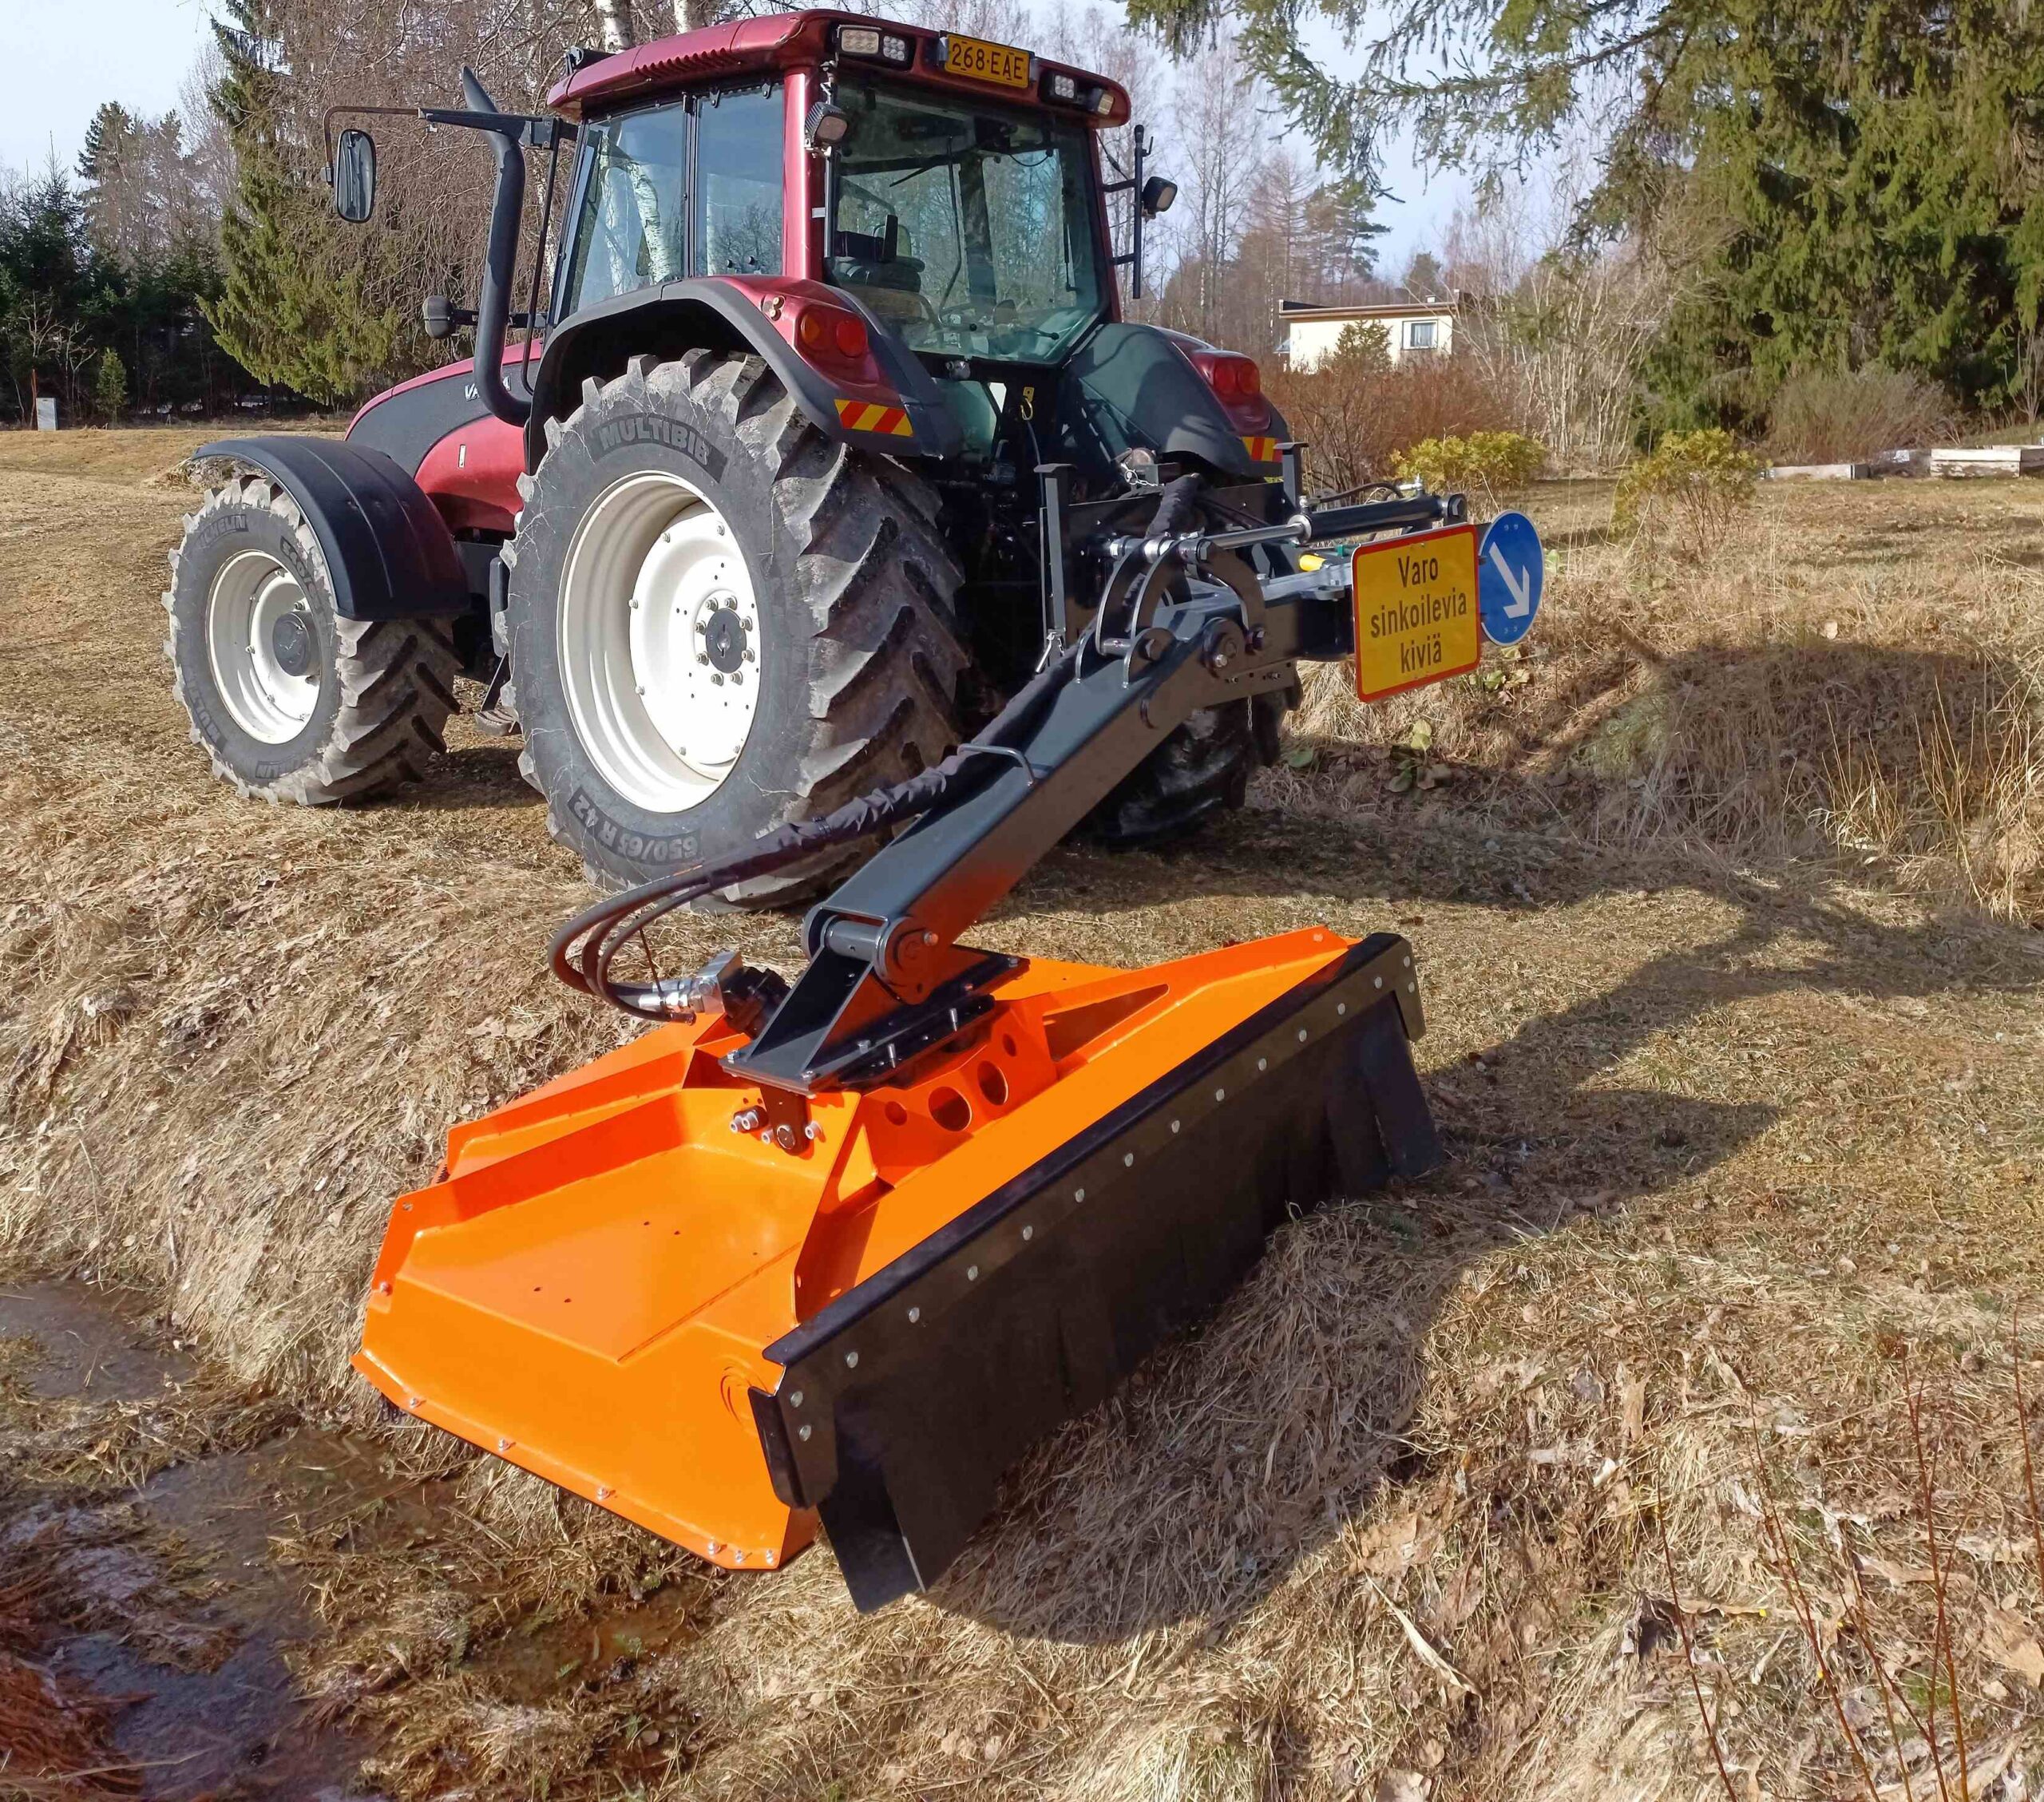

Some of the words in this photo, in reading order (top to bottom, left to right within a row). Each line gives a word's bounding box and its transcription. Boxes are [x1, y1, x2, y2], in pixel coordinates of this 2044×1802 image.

[600, 417, 711, 465] MULTIBIB
[1397, 556, 1439, 588] Varo
[1370, 587, 1468, 639] sinkoilevia
[1400, 632, 1442, 674] kiviä
[598, 820, 618, 846] R
[617, 833, 699, 863] 650/65
